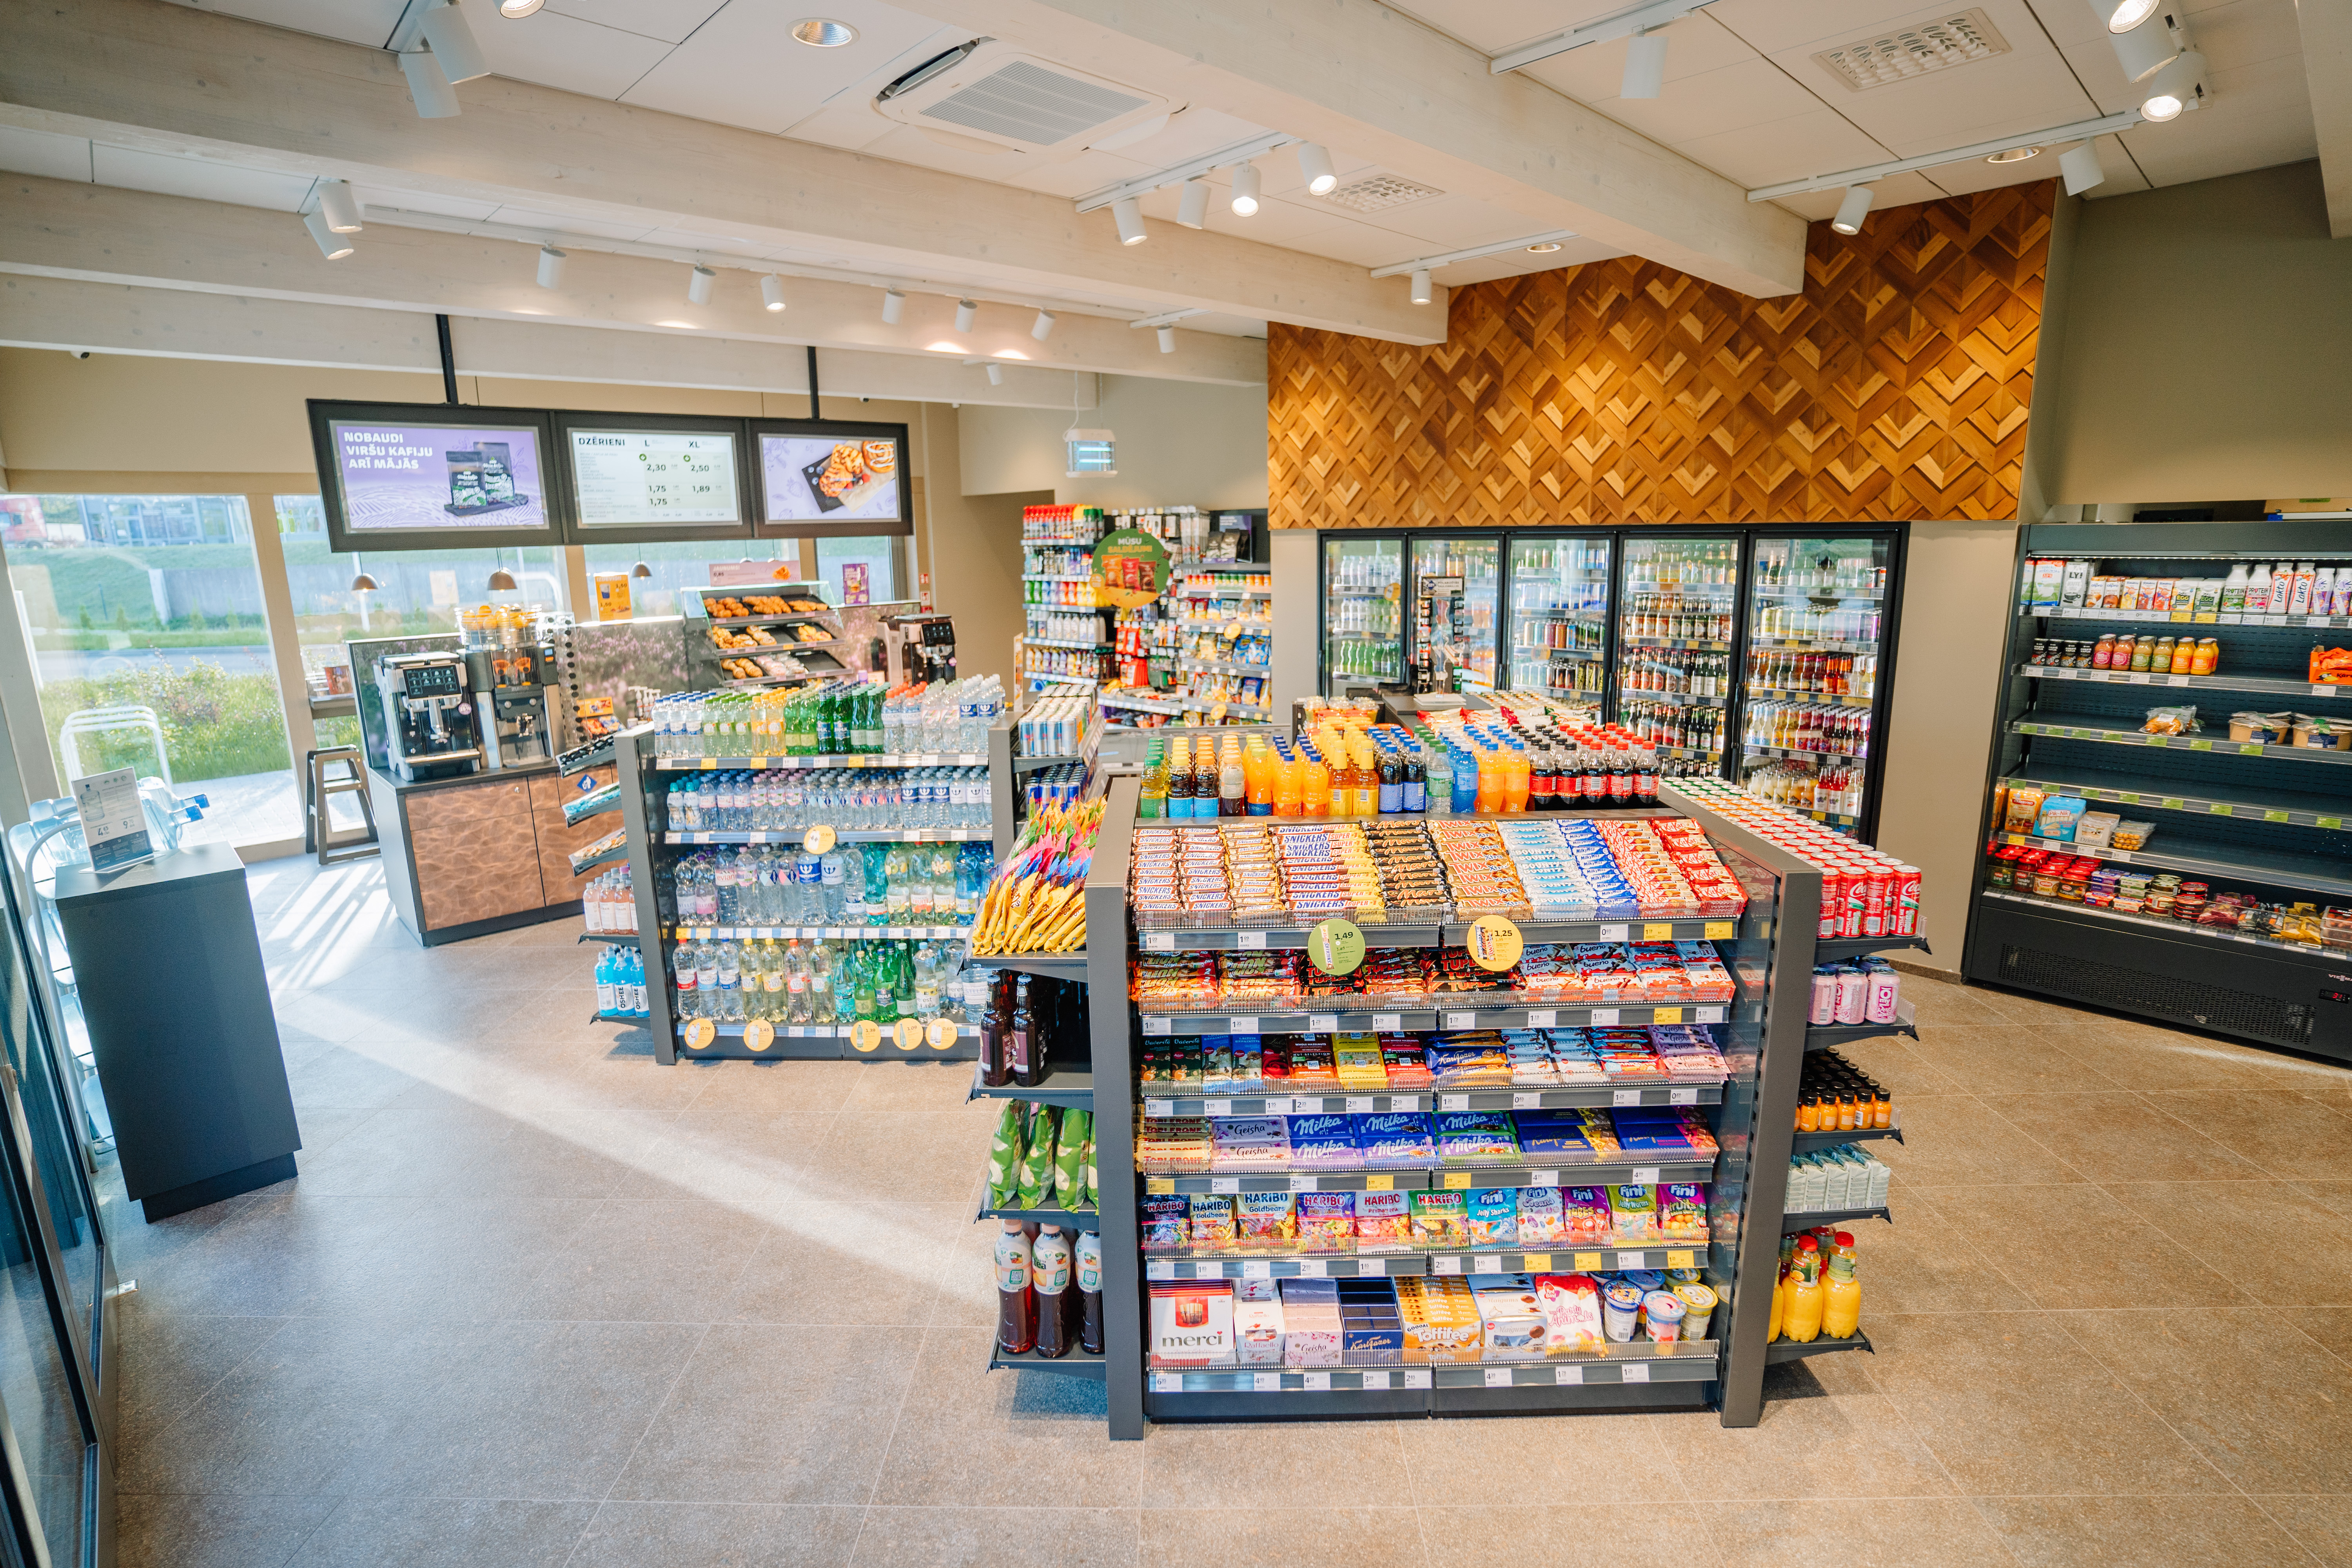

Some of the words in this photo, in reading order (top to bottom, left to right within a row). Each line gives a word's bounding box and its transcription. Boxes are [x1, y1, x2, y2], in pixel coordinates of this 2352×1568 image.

[344, 432, 403, 443] NOBAUDI
[579, 436, 625, 446] DZĒRIENI
[346, 443, 385, 456] VIRŠU
[388, 446, 432, 457] KAFIJU
[349, 457, 371, 469] ARĪ
[374, 458, 419, 469] MĀJĀS
[646, 464, 666, 473] 2,30
[691, 465, 709, 473] 2,50
[648, 485, 666, 494] 1,75
[692, 485, 710, 494] 1,89
[650, 498, 668, 507] 1,75
[1118, 536, 1142, 545] MŪSU
[2274, 581, 2285, 603] Lakto
[2295, 581, 2308, 604] Lakto
[1377, 820, 1421, 830] Mars
[1663, 822, 1684, 833] KitKat
[1284, 833, 1328, 844] SNICKERS
[1675, 837, 1697, 848] KitKat
[1392, 861, 1437, 873] Mars
[717, 873, 735, 881] evian
[1398, 889, 1443, 900] Mars
[1335, 931, 1353, 940] 1,49
[1526, 946, 1548, 956] bueno
[1580, 944, 1606, 954] bueno
[1365, 964, 1402, 975] TUPLA
[1527, 962, 1549, 971] bueno
[1584, 960, 1609, 968] bueno
[1312, 986, 1353, 996] TUPLA
[1670, 1034, 1690, 1043] Geisha
[1294, 1115, 1344, 1135] Milka
[1366, 1114, 1409, 1131] Milka
[1446, 1114, 1488, 1129] Milka
[1244, 1192, 1289, 1204] HARIBO
[1480, 1190, 1504, 1205] Fini
[1528, 1187, 1547, 1198] Fini
[1572, 1189, 1593, 1201] Fini
[1148, 1201, 1185, 1212] HARIBO
[1192, 1200, 1231, 1212] HARIBO
[1523, 1198, 1555, 1207] Beans
[1618, 1200, 1631, 1209] Jelly
[1630, 1200, 1649, 1208] Worms
[1669, 1200, 1697, 1212] fruits
[1308, 1207, 1325, 1216] Jelly
[1477, 1208, 1490, 1217] Jelly
[1491, 1207, 1510, 1216] Sharks
[1567, 1207, 1594, 1218] TUBES
[1558, 1305, 1582, 1317] Party
[1407, 1323, 1430, 1332] GOOOAL
[1162, 1331, 1223, 1347] merci
[1413, 1326, 1470, 1343] Toffifee
[1244, 1341, 1279, 1349] Raffaello
